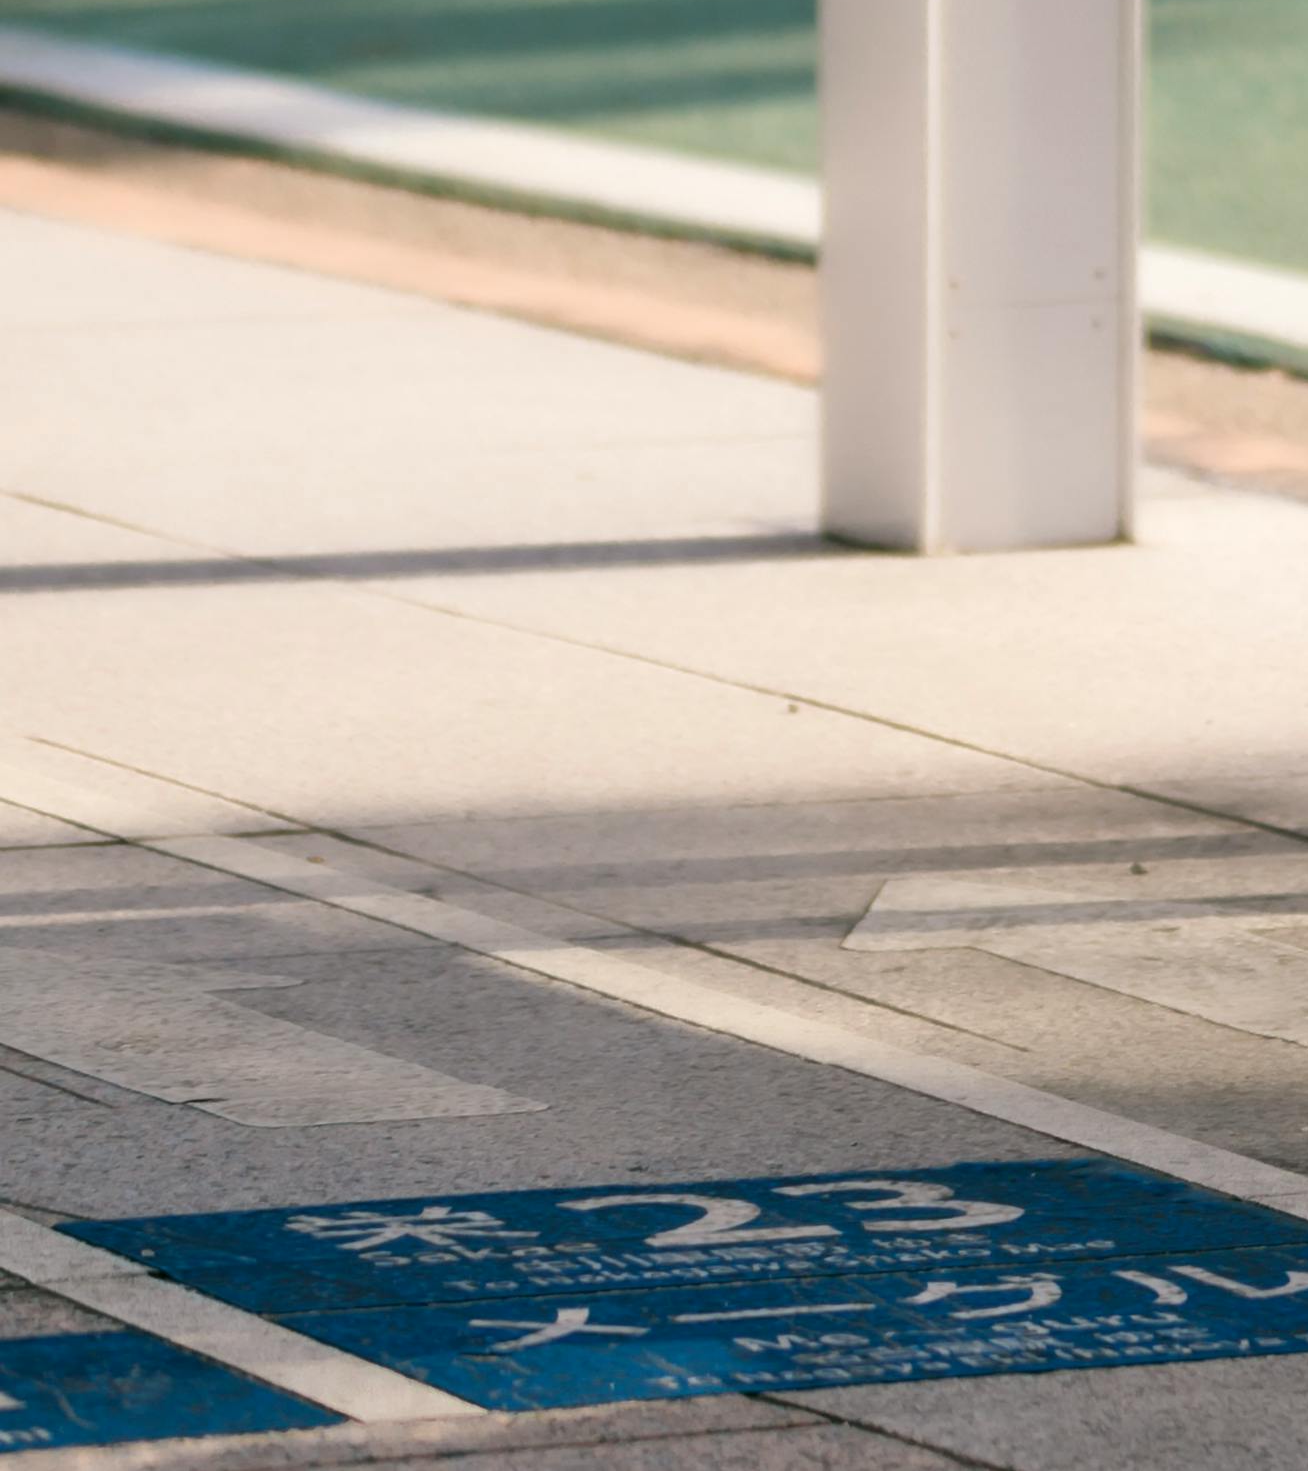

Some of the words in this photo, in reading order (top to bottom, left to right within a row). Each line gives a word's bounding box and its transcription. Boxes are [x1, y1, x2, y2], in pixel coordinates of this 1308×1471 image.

[285, 1205, 540, 1254] 栄
[556, 1177, 1028, 1247] 23
[361, 1240, 598, 1268] Sakae
